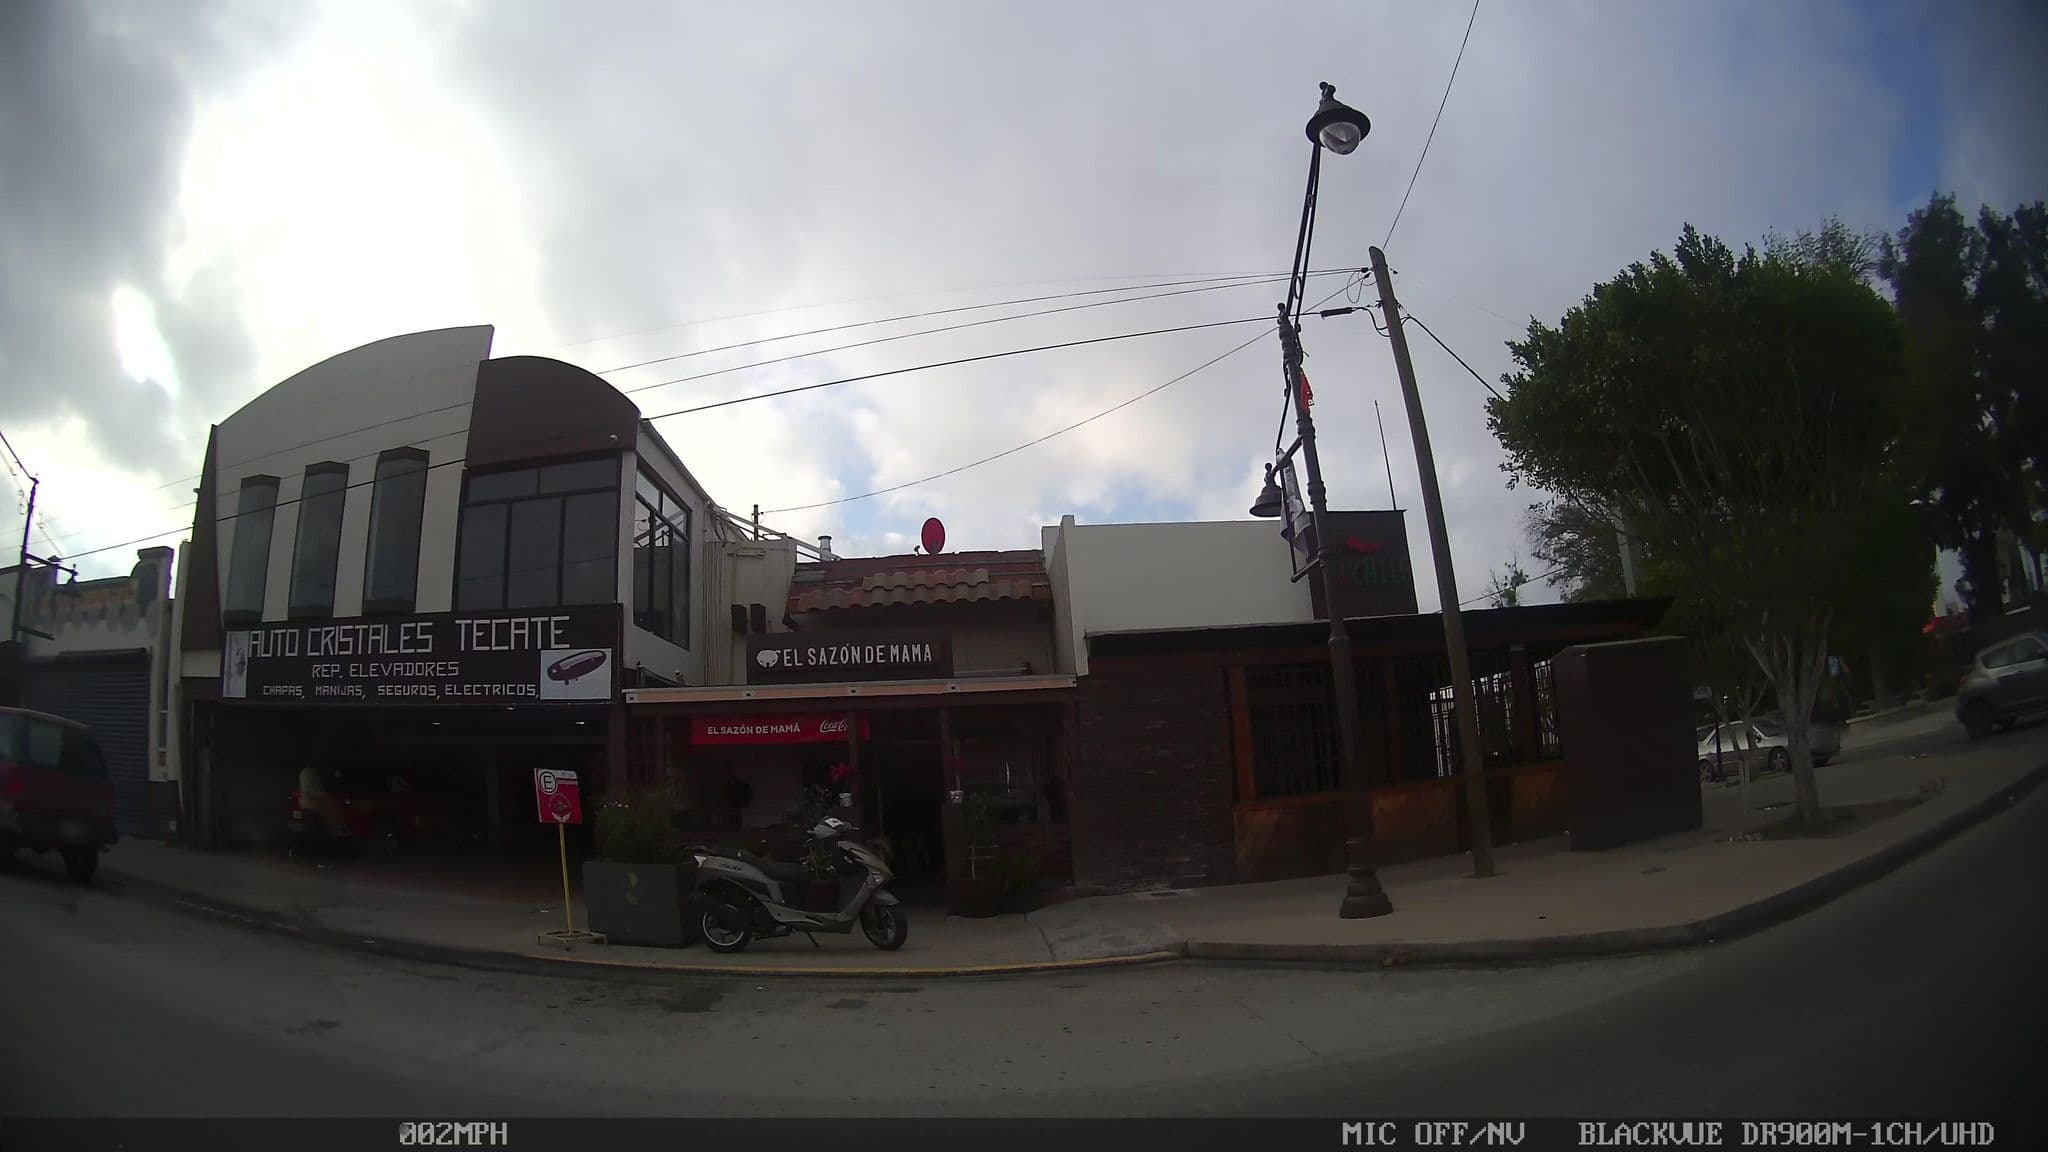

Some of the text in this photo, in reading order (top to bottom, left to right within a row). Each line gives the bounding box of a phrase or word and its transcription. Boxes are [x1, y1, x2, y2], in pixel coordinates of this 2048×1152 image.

[248, 615, 570, 658] AUTO CRISTALES TECATE
[783, 642, 933, 667] EL SAZÓN DE MAMA
[312, 661, 460, 679] REP. ELEVADORES
[263, 685, 305, 700] CHAPAS,
[377, 684, 440, 700] SEGUROS,
[707, 722, 801, 735] EL SAZÓN DE MAMÁ
[543, 775, 553, 790] E
